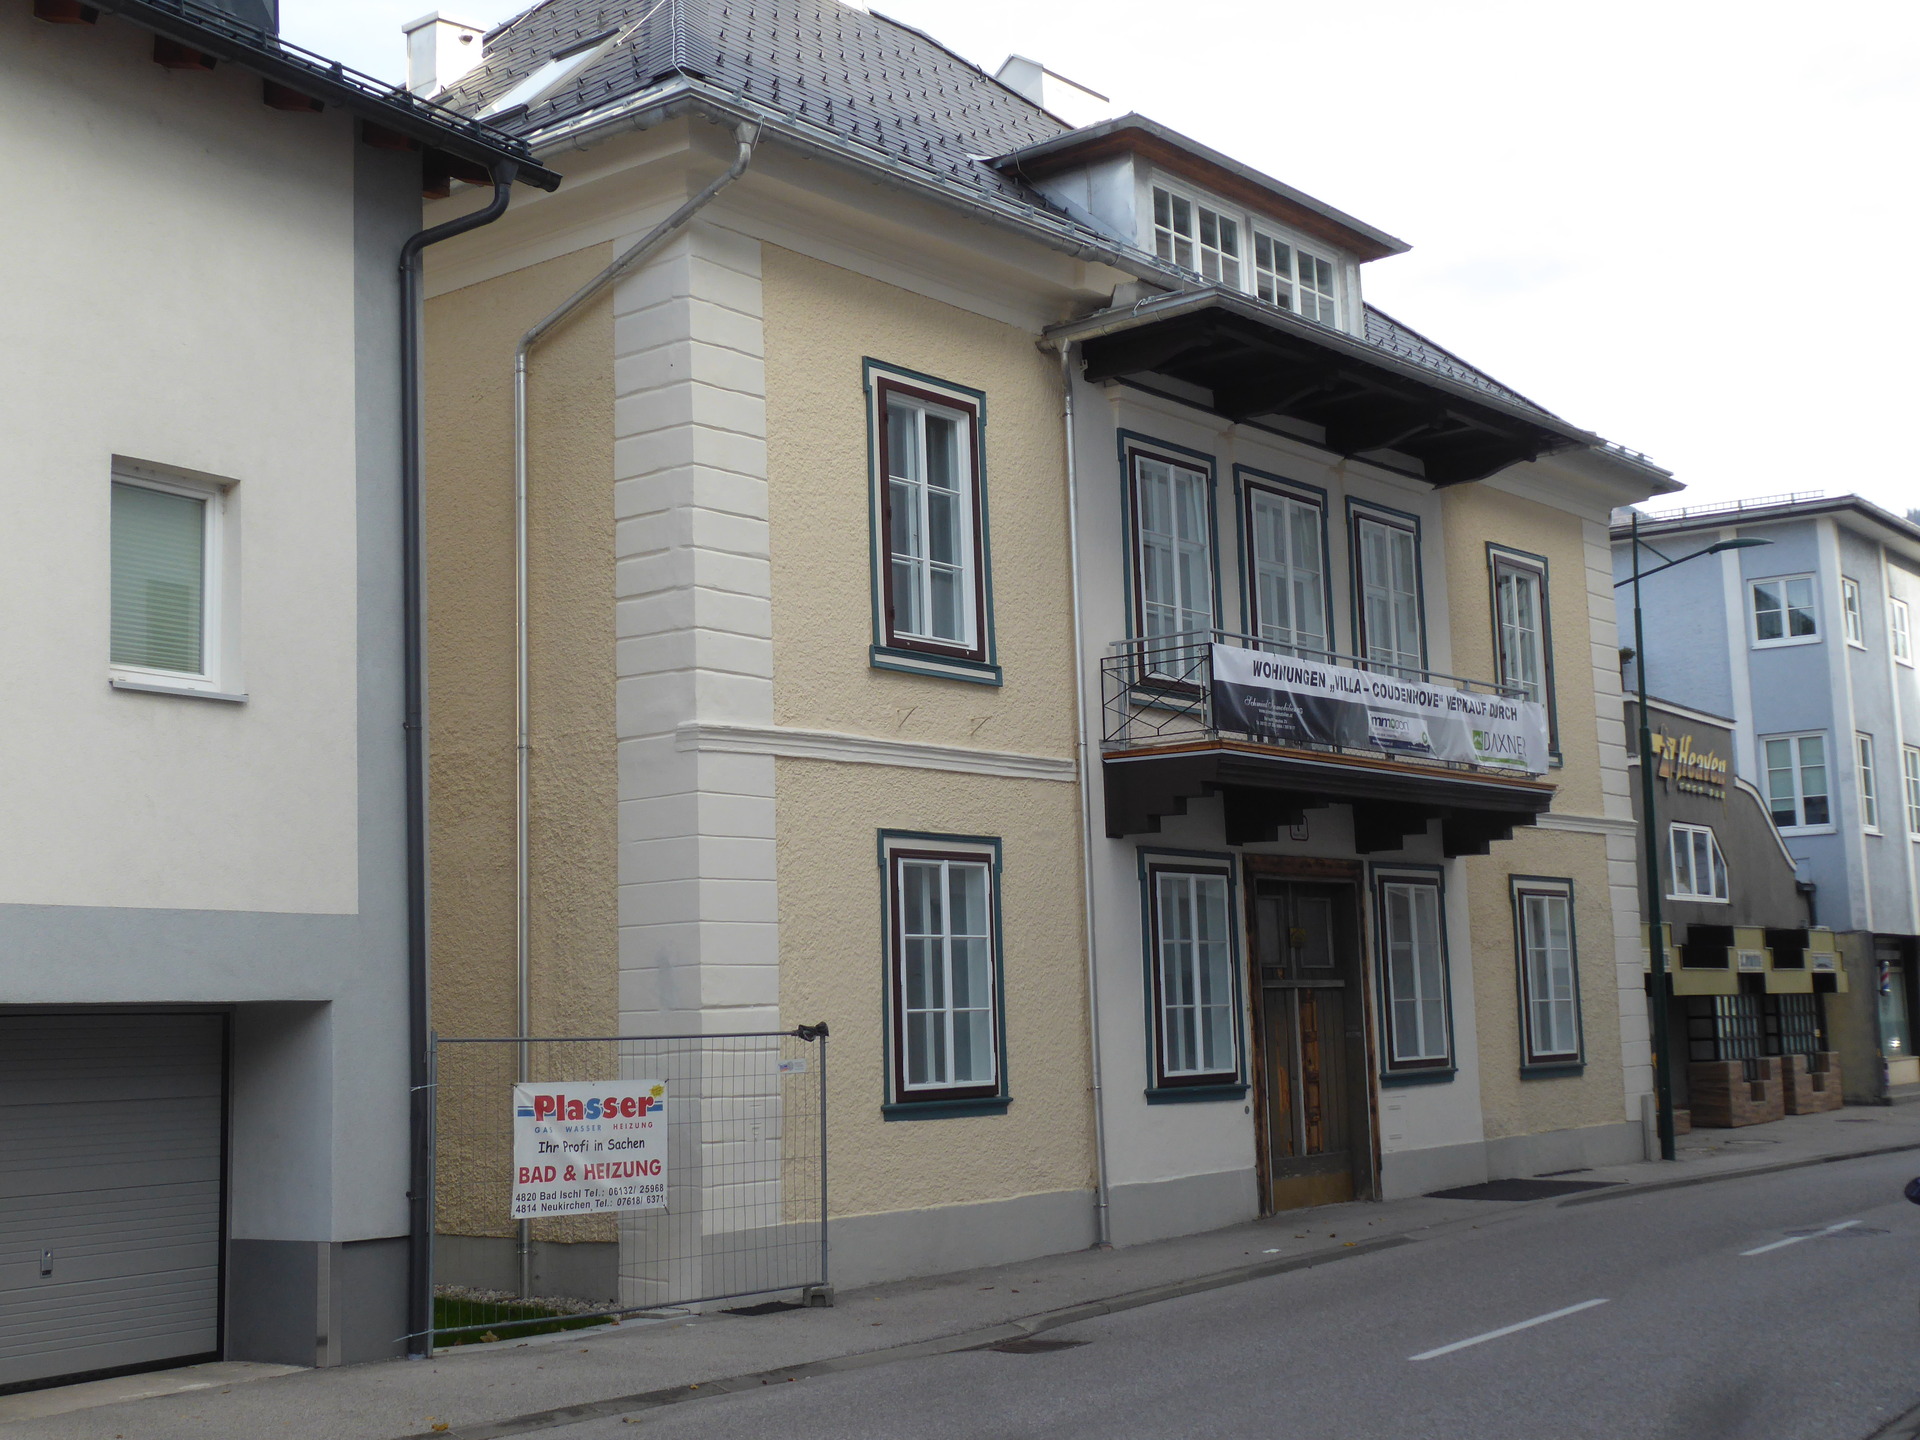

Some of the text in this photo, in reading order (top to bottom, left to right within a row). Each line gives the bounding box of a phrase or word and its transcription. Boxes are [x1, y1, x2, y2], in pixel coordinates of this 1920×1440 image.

[1253, 660, 1326, 688] WOHNUNGEN
[534, 1094, 654, 1121] Plasser
[534, 1121, 653, 1134] GAS WASSER HEIZUNG
[538, 1137, 645, 1153] Ihr Profi in Sachen
[519, 1159, 662, 1184] BAD & HEIZUNG
[515, 1192, 537, 1202] 4820
[539, 1191, 557, 1201] Bad
[559, 1189, 581, 1199] Ischl
[584, 1187, 605, 1198] Tel.:
[639, 1184, 664, 1194] 25968
[515, 1203, 537, 1213] 4814
[541, 1201, 591, 1212] Neukirchen
[595, 1199, 613, 1208] Tel.:
